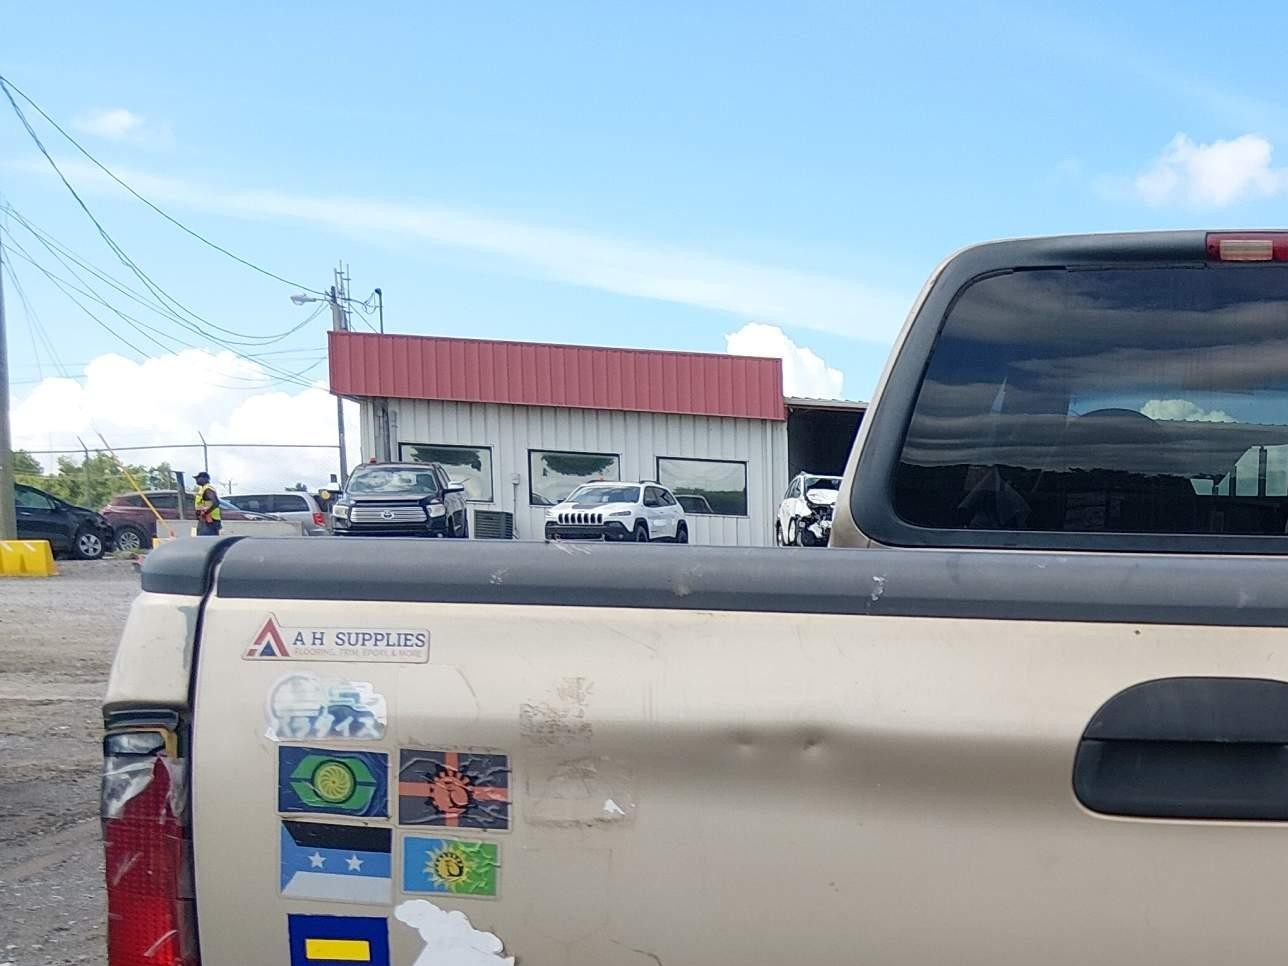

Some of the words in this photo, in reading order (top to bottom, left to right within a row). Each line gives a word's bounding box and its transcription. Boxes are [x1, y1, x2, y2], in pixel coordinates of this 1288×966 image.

[292, 631, 305, 646] A
[311, 631, 325, 646] H
[335, 632, 426, 648] SUPPLIES
